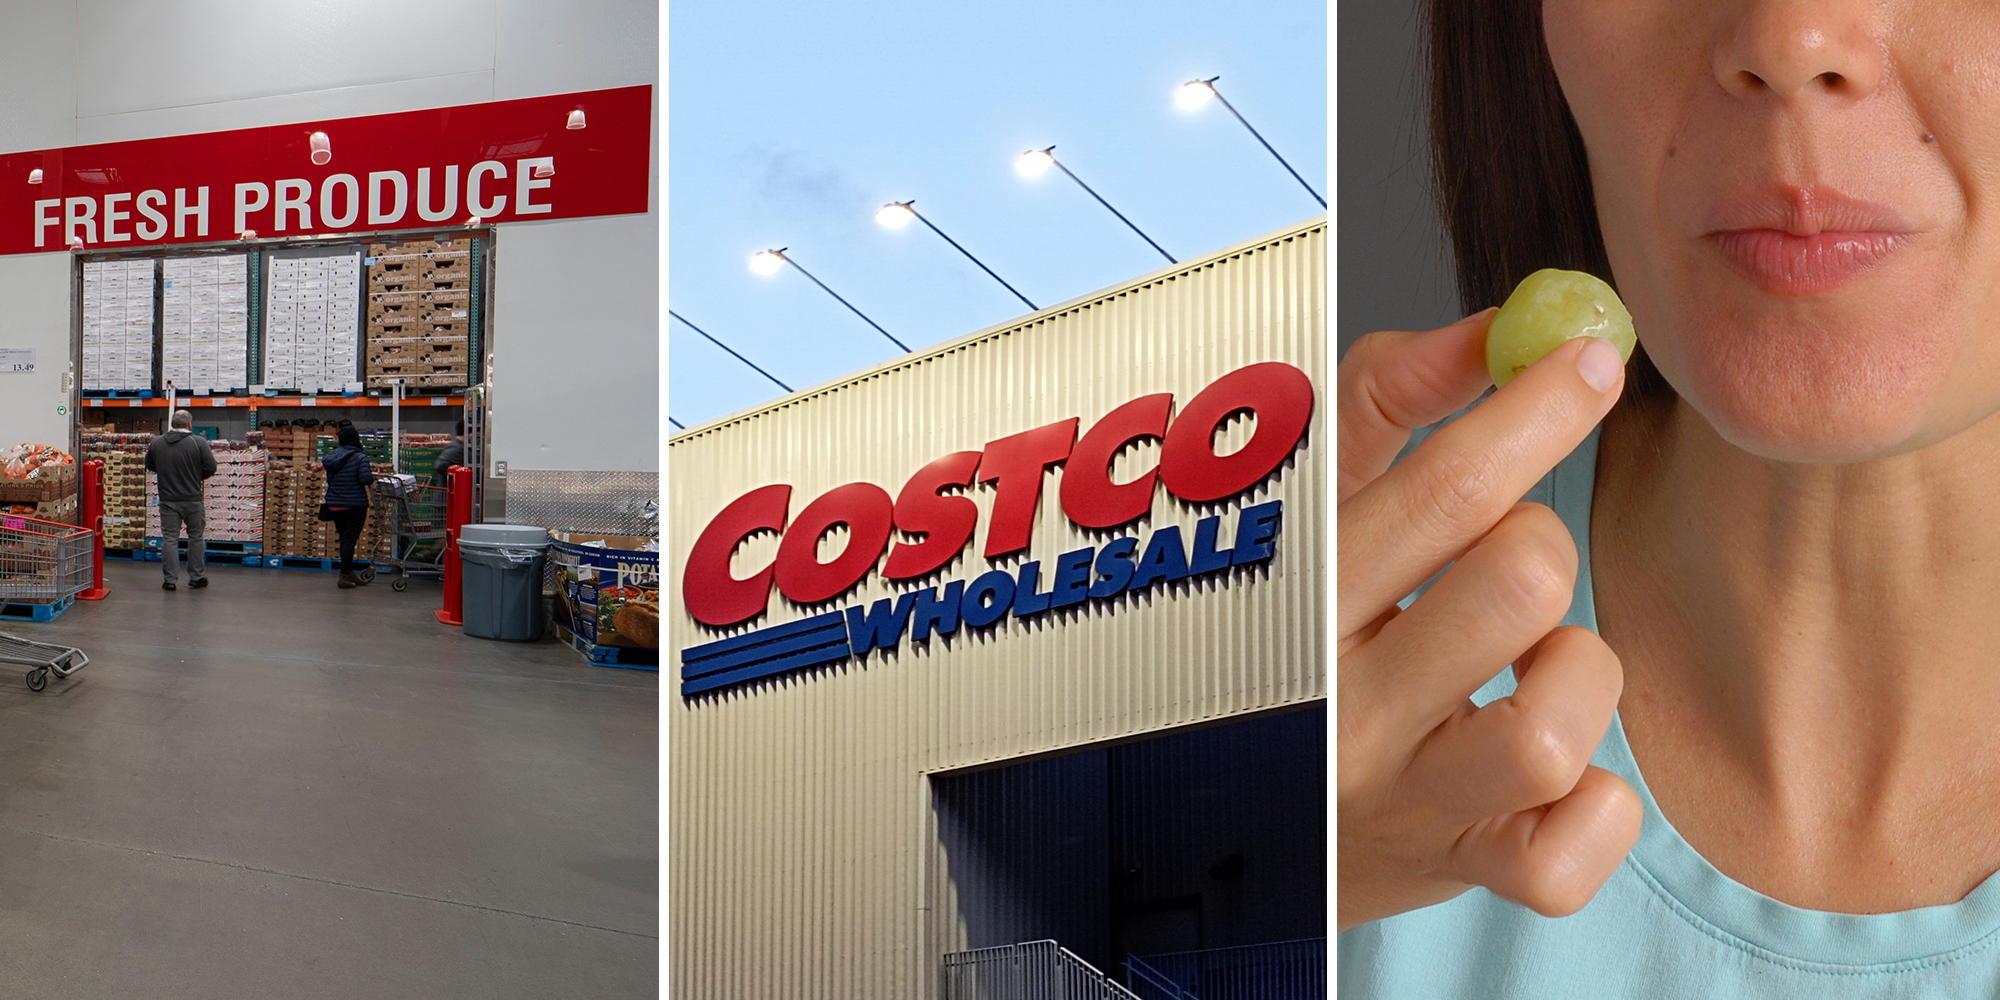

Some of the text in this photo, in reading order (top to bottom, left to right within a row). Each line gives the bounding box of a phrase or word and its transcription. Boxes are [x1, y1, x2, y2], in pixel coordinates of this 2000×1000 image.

[34, 156, 554, 248] FRESH PRODUCE
[386, 273, 416, 283] organic
[436, 271, 468, 280] organic
[386, 294, 416, 303] organic
[435, 292, 467, 301] organic
[385, 315, 415, 324] organic
[384, 356, 415, 365] organic
[434, 355, 465, 364] organic
[13, 363, 35, 371] 13.49
[434, 376, 465, 385] organic
[682, 361, 1314, 626] COSTCO
[616, 562, 659, 590] POTA
[846, 499, 1283, 655] WHOLESALE
